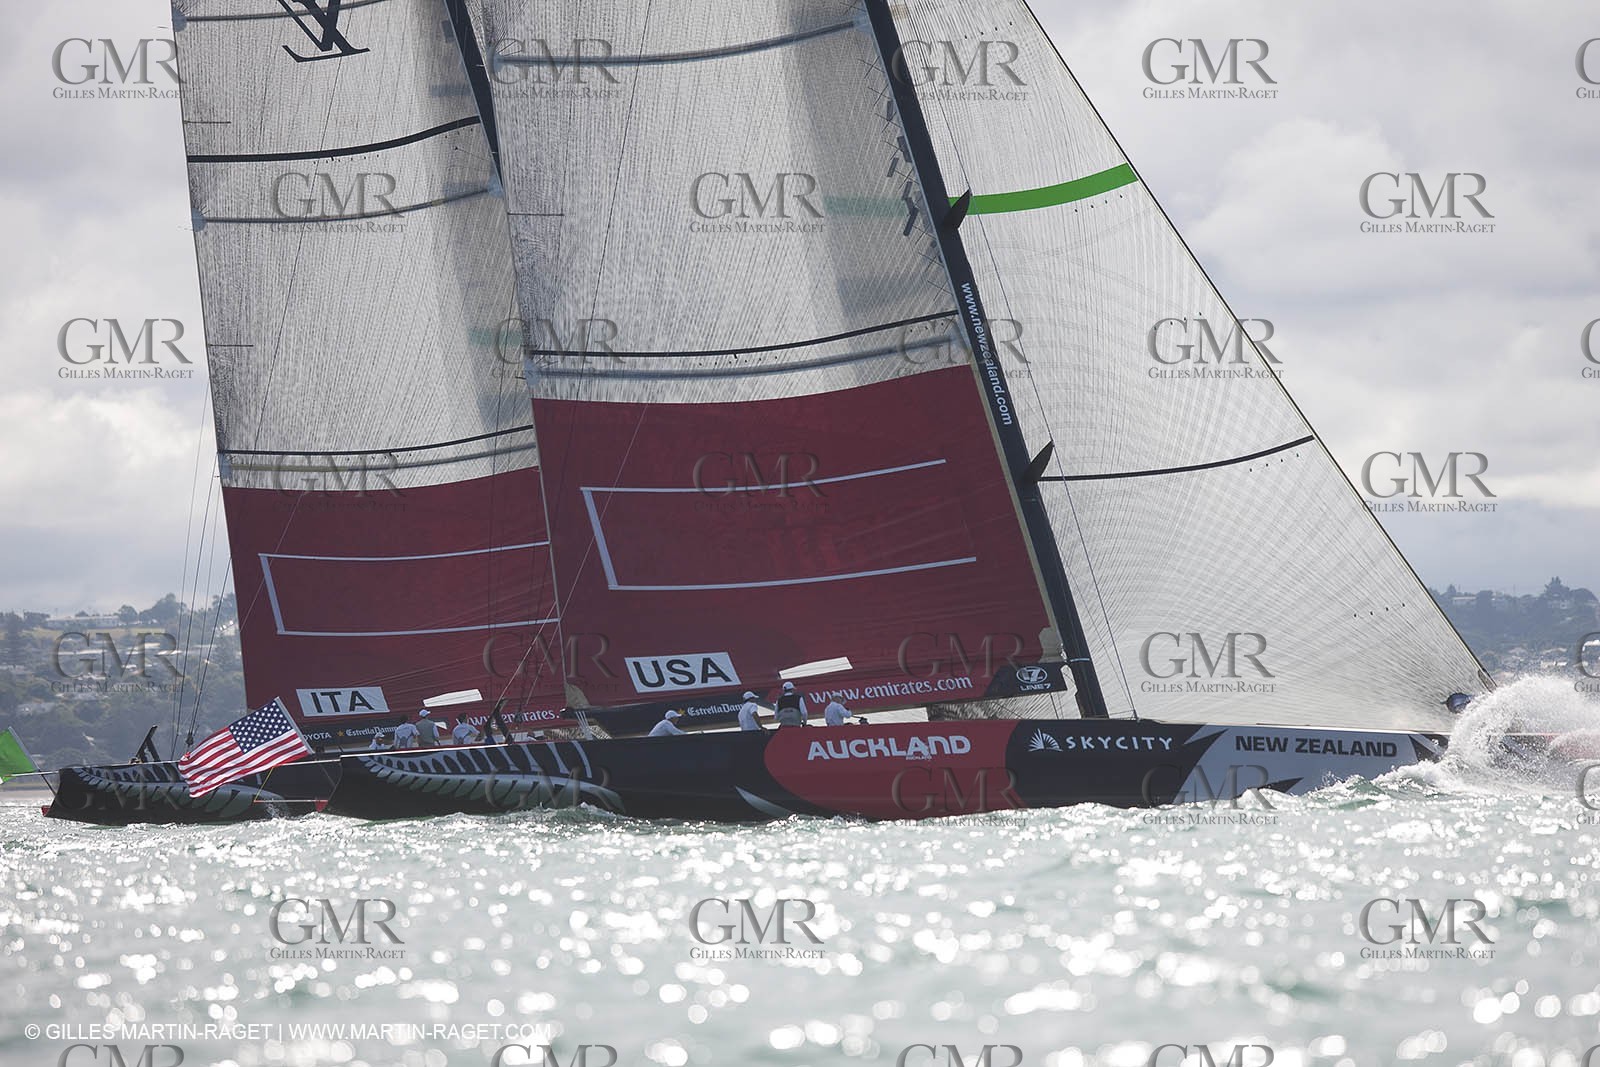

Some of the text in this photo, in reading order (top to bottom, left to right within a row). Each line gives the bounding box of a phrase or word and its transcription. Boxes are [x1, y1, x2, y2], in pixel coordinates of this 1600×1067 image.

[961, 282, 1013, 426] www.newzealand.com
[633, 657, 732, 688] USA
[310, 690, 375, 713] ITA
[809, 676, 973, 704] www.emirates.com
[303, 732, 332, 741] OYOTA
[807, 735, 972, 760] AUCKLAND
[1066, 736, 1173, 750] SKYCITY
[1235, 735, 1398, 758] NEW ZEALAND
